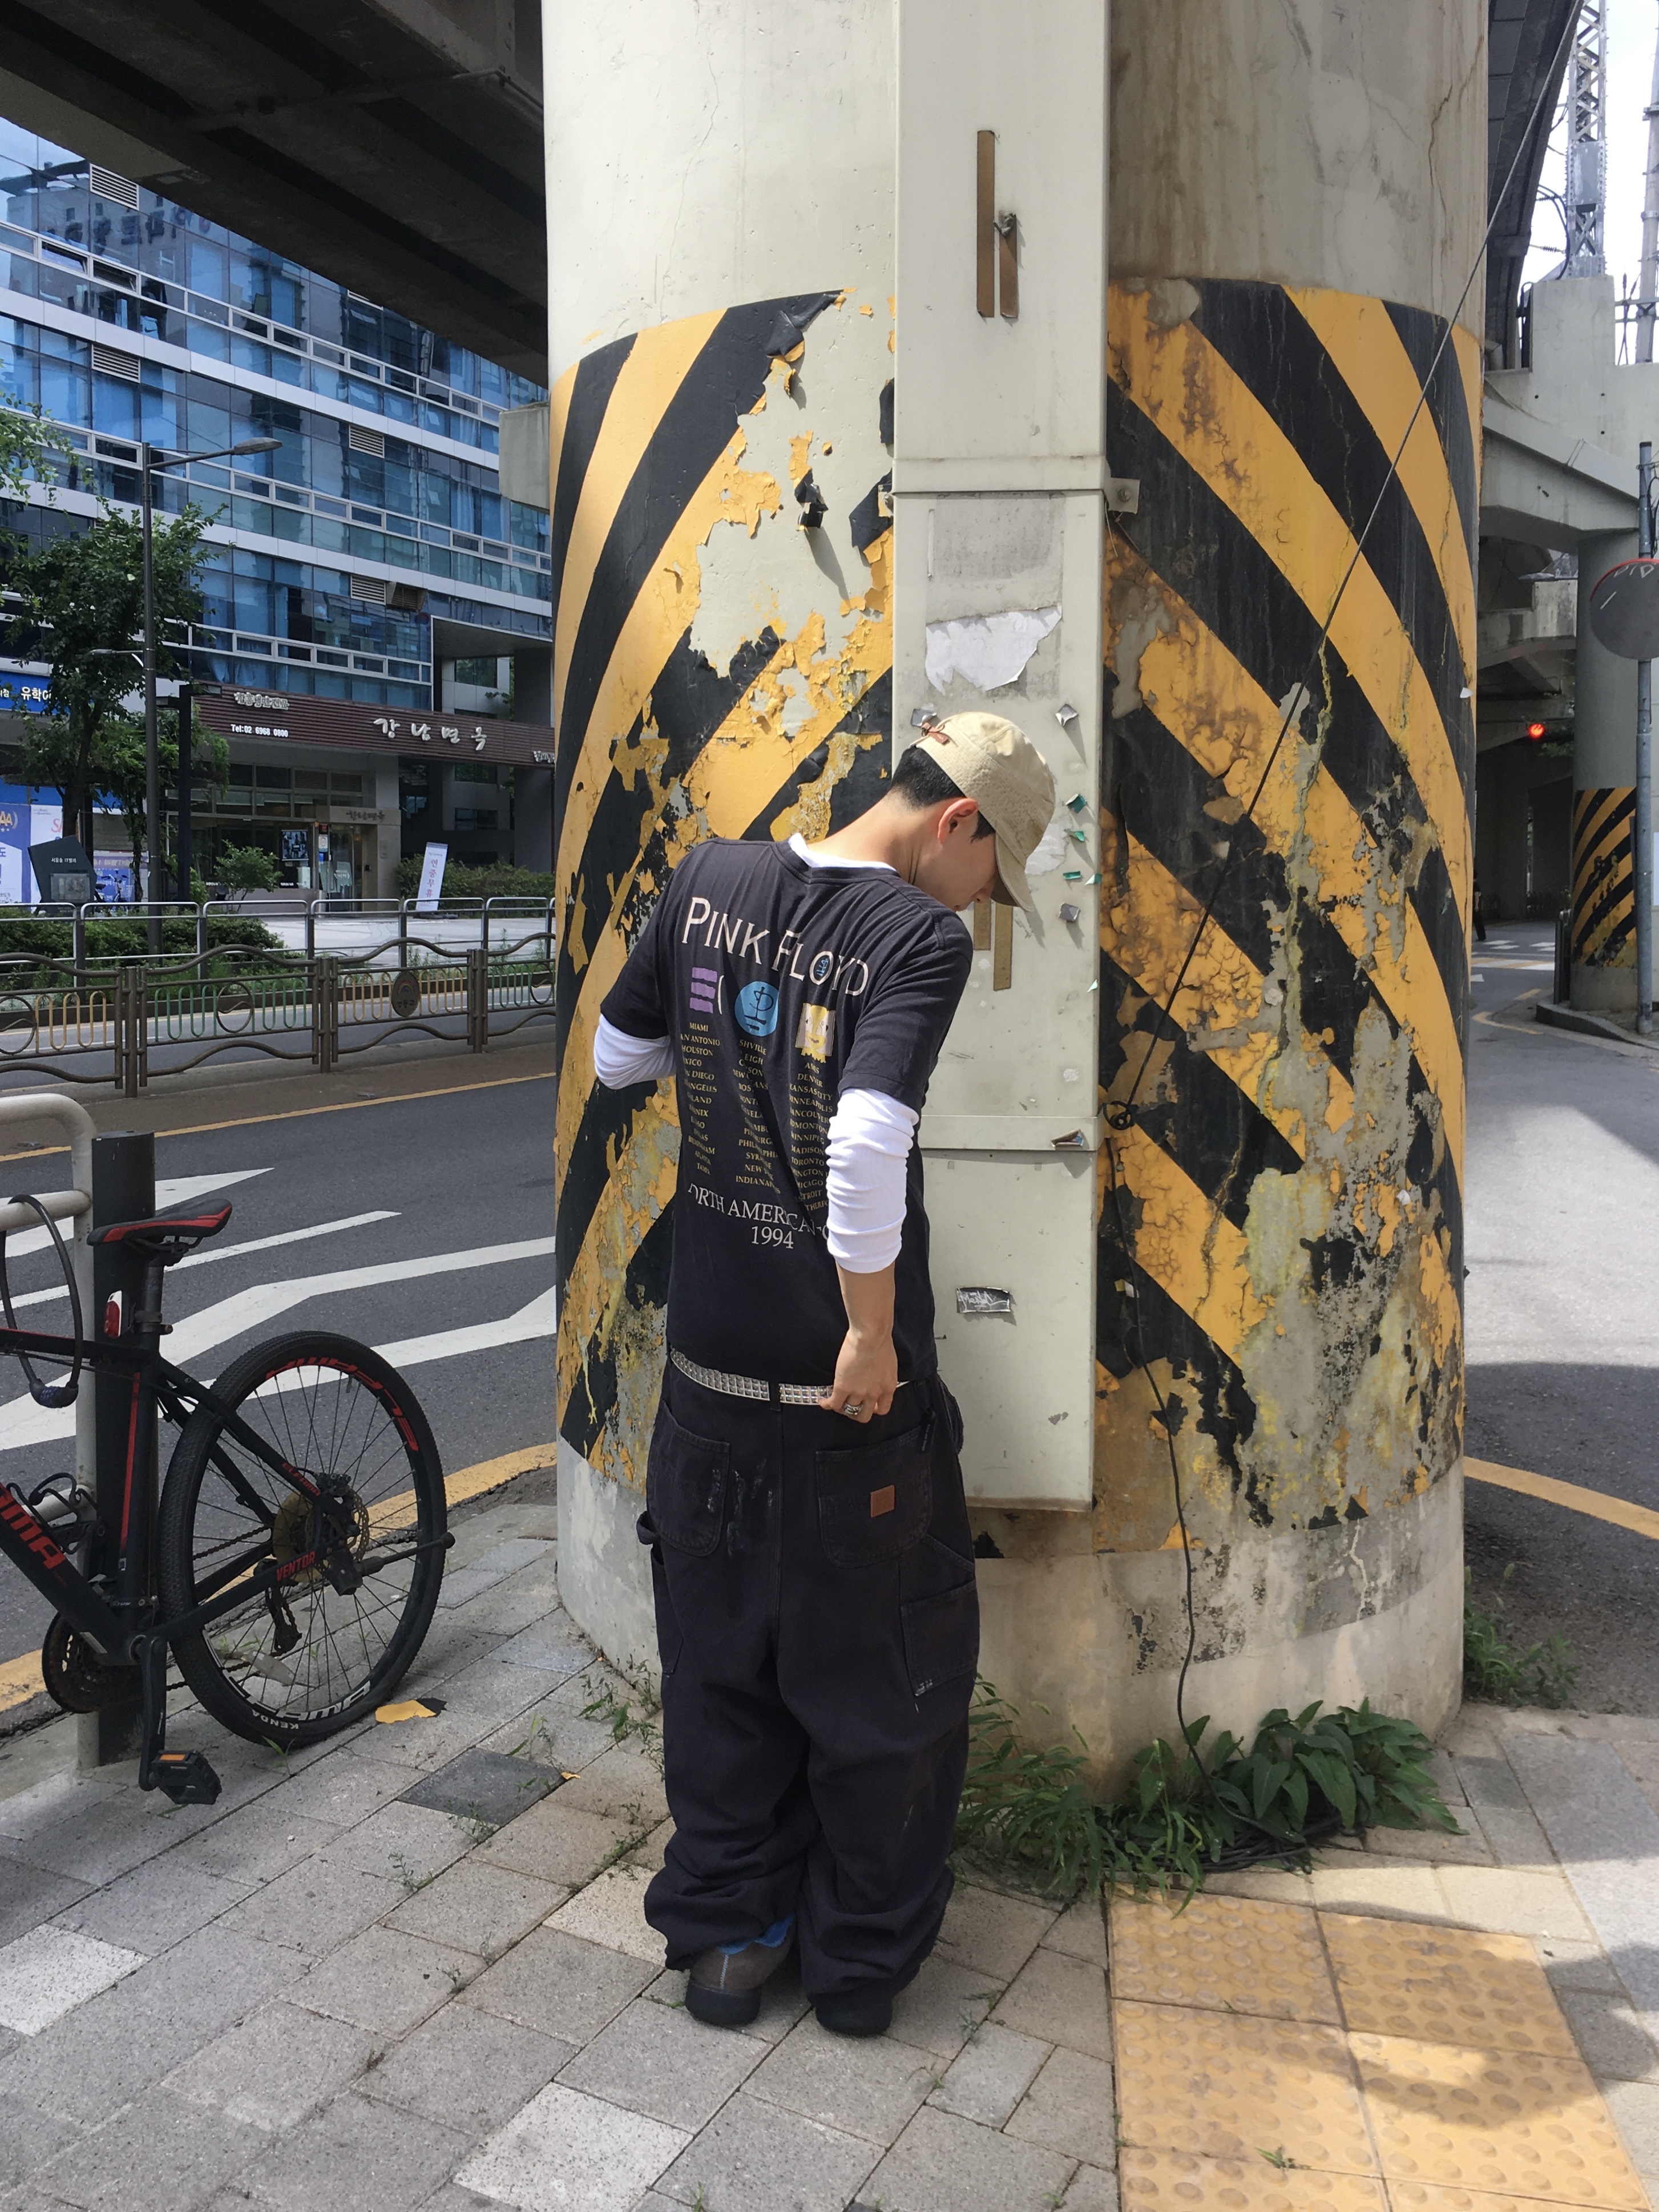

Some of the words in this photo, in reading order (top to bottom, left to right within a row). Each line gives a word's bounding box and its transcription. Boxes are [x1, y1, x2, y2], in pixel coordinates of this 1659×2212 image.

[231, 723, 252, 734] Tel:02
[255, 726, 271, 735] 6968
[273, 728, 289, 738] 0800
[681, 896, 770, 965] PINK
[771, 929, 869, 996] FLOYD
[689, 1022, 708, 1032] MIAMI
[691, 1036, 720, 1046] ANTONIO
[739, 1039, 767, 1056] SHVILLE
[684, 1057, 702, 1066] XICO
[744, 1053, 764, 1065] EIGH
[692, 1070, 715, 1081] DIEGO
[797, 1073, 823, 1087] DENVER
[791, 1156, 825, 1166] TORONTO
[745, 1164, 762, 1172] NEW
[801, 1190, 822, 1200] TROIT
[751, 1225, 794, 1249] 1994
[276, 1551, 316, 1582] VENTOR
[252, 1709, 300, 1730] KENDA
